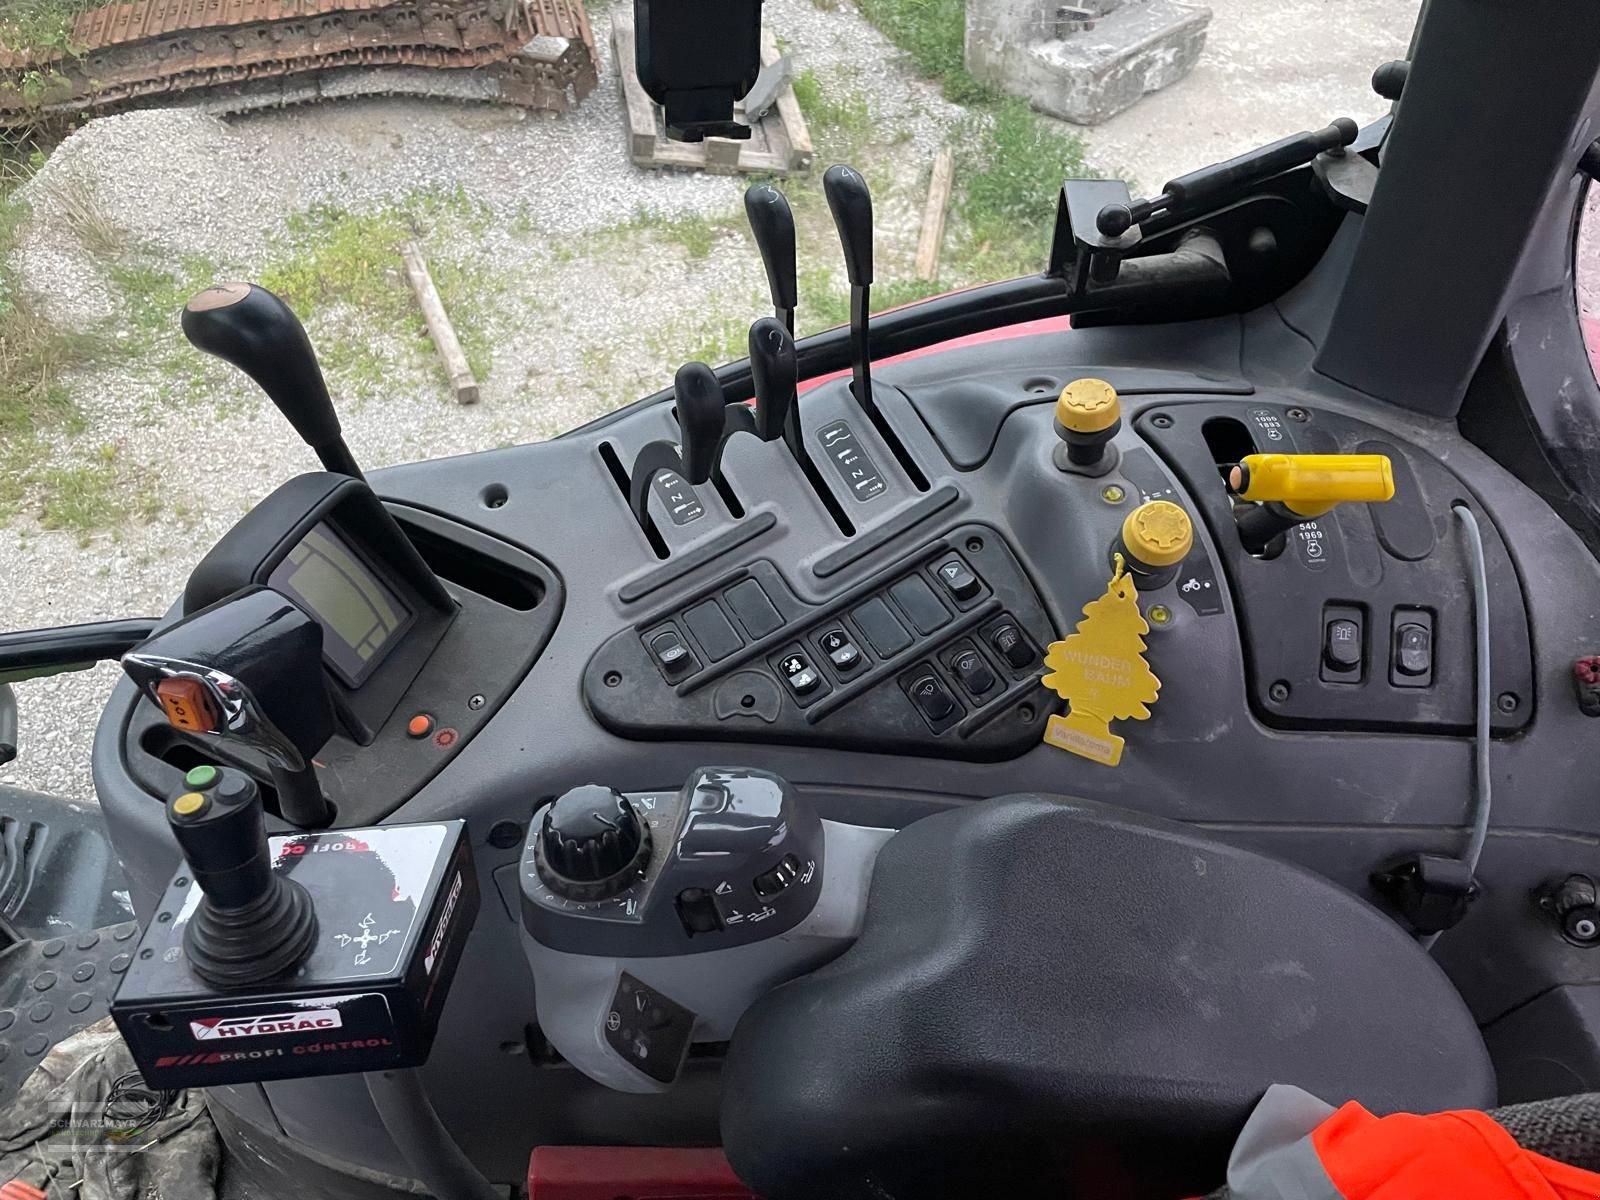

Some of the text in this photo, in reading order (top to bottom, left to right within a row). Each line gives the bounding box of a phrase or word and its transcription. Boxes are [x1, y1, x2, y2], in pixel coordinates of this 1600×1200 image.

[841, 168, 858, 183] 4
[760, 185, 780, 204] 3
[1299, 522, 1318, 531] 540
[1299, 531, 1323, 540] 1969
[1064, 648, 1132, 672] WUNDER
[1083, 669, 1131, 690] BAUM
[218, 1017, 335, 1037] HYDRAC
[219, 1037, 393, 1062] PROFI CONTROL
